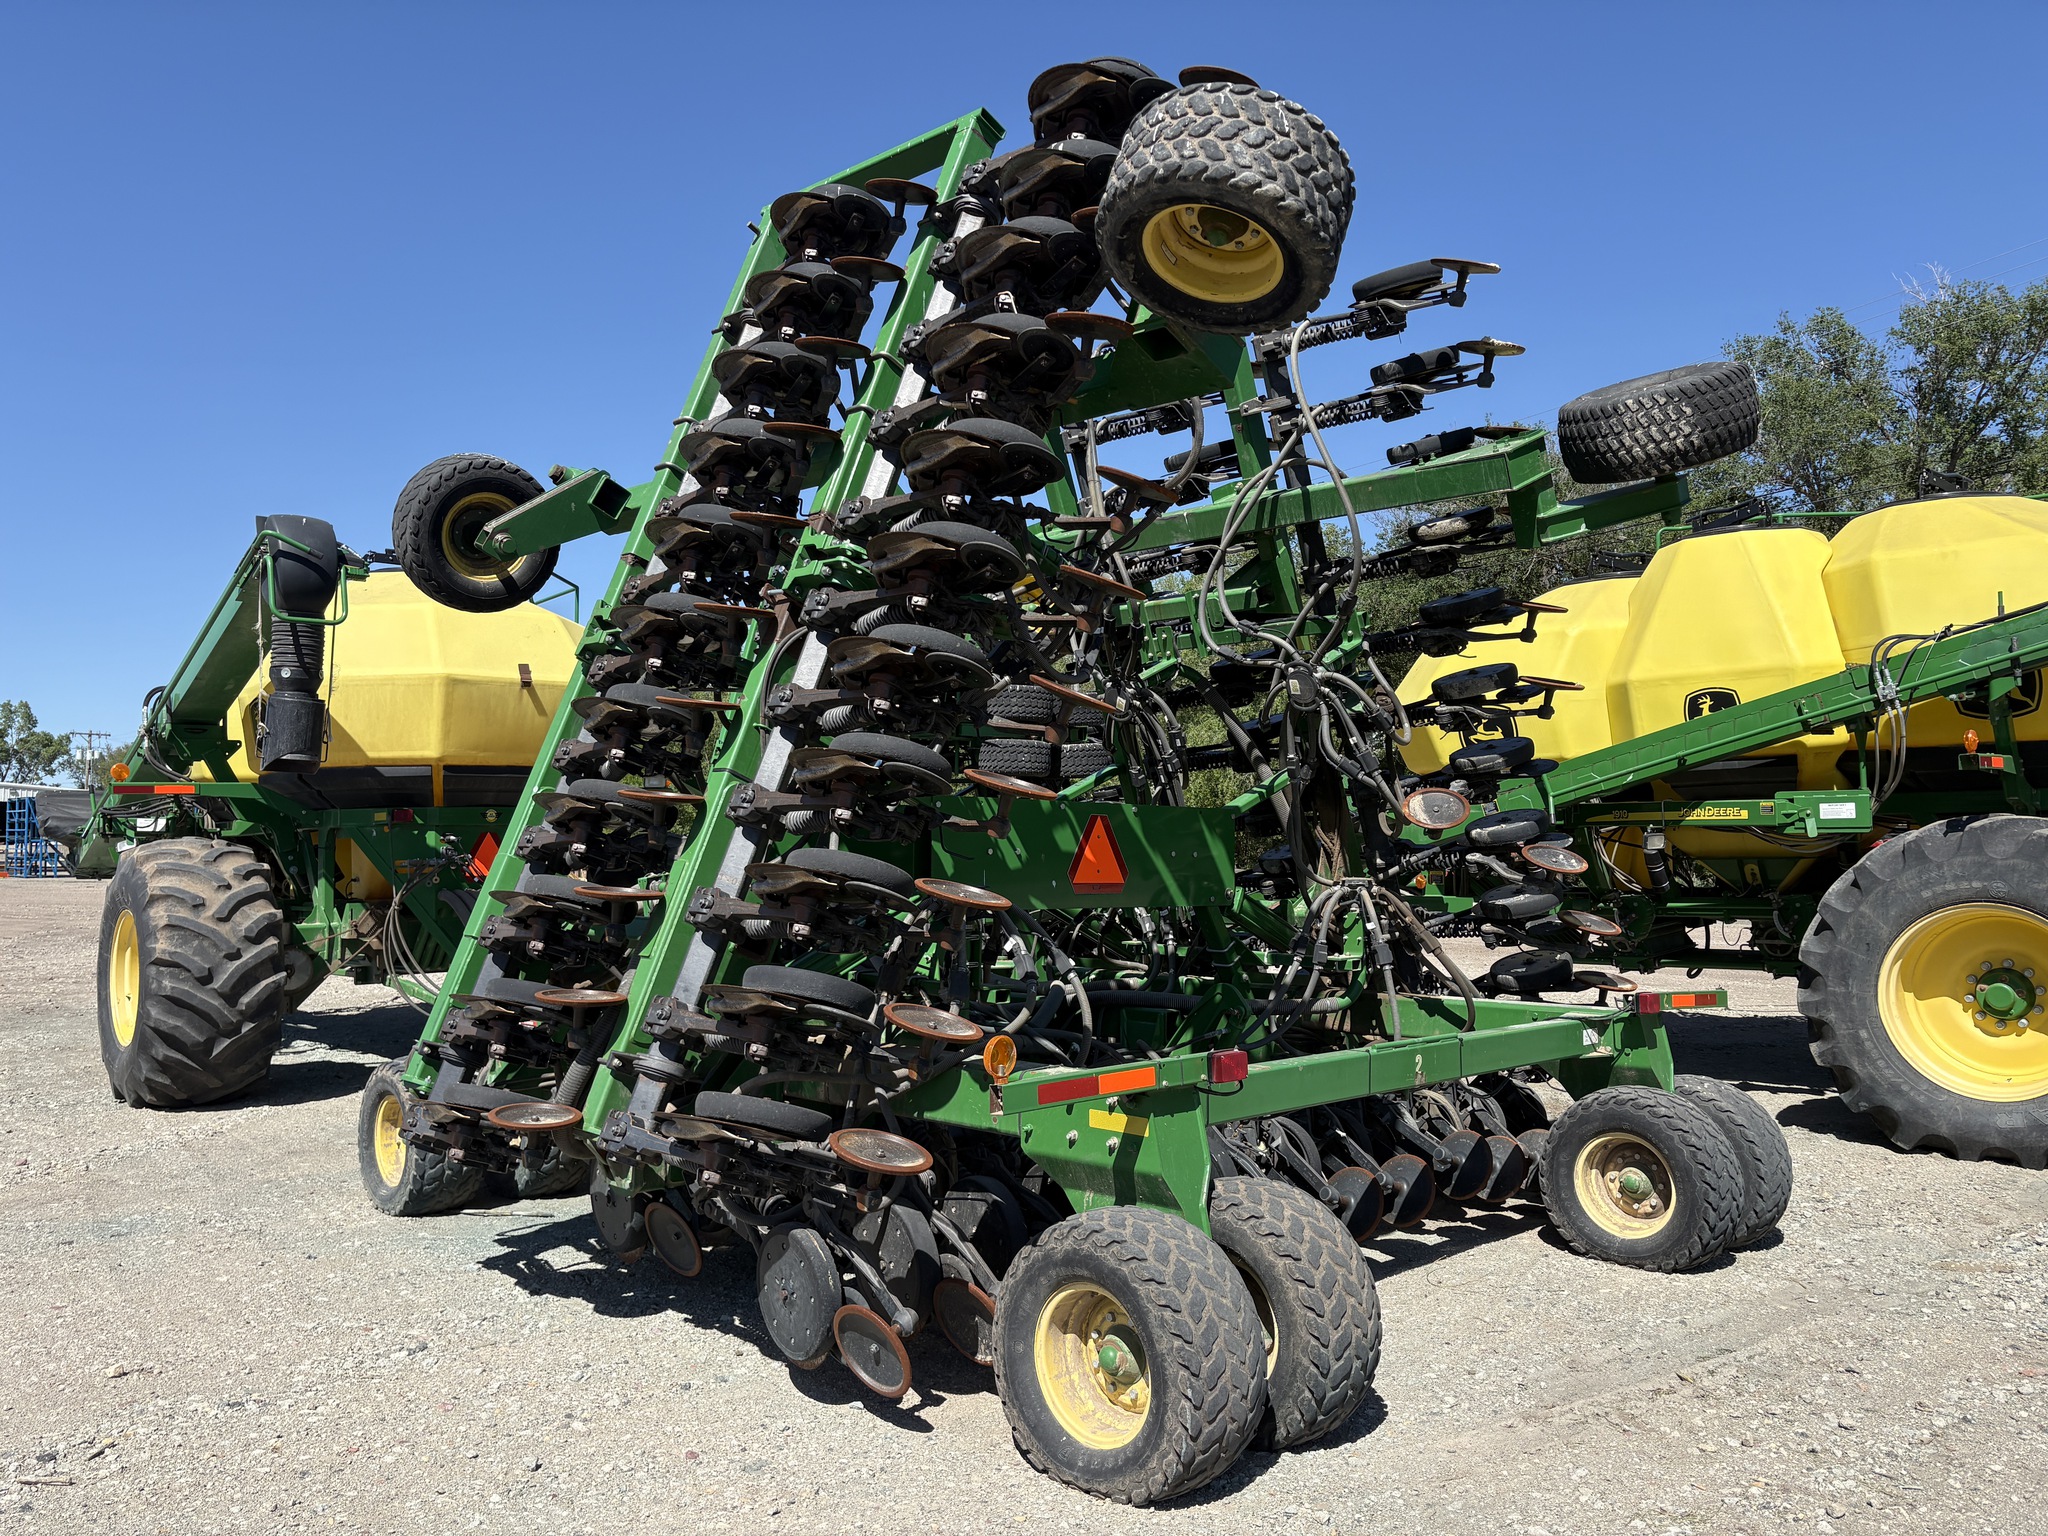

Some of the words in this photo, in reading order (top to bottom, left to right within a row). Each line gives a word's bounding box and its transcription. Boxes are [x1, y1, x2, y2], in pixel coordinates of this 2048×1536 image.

[1612, 809, 1629, 819] 1910
[1679, 807, 1705, 817] JOHN
[1705, 806, 1742, 817] DEERE
